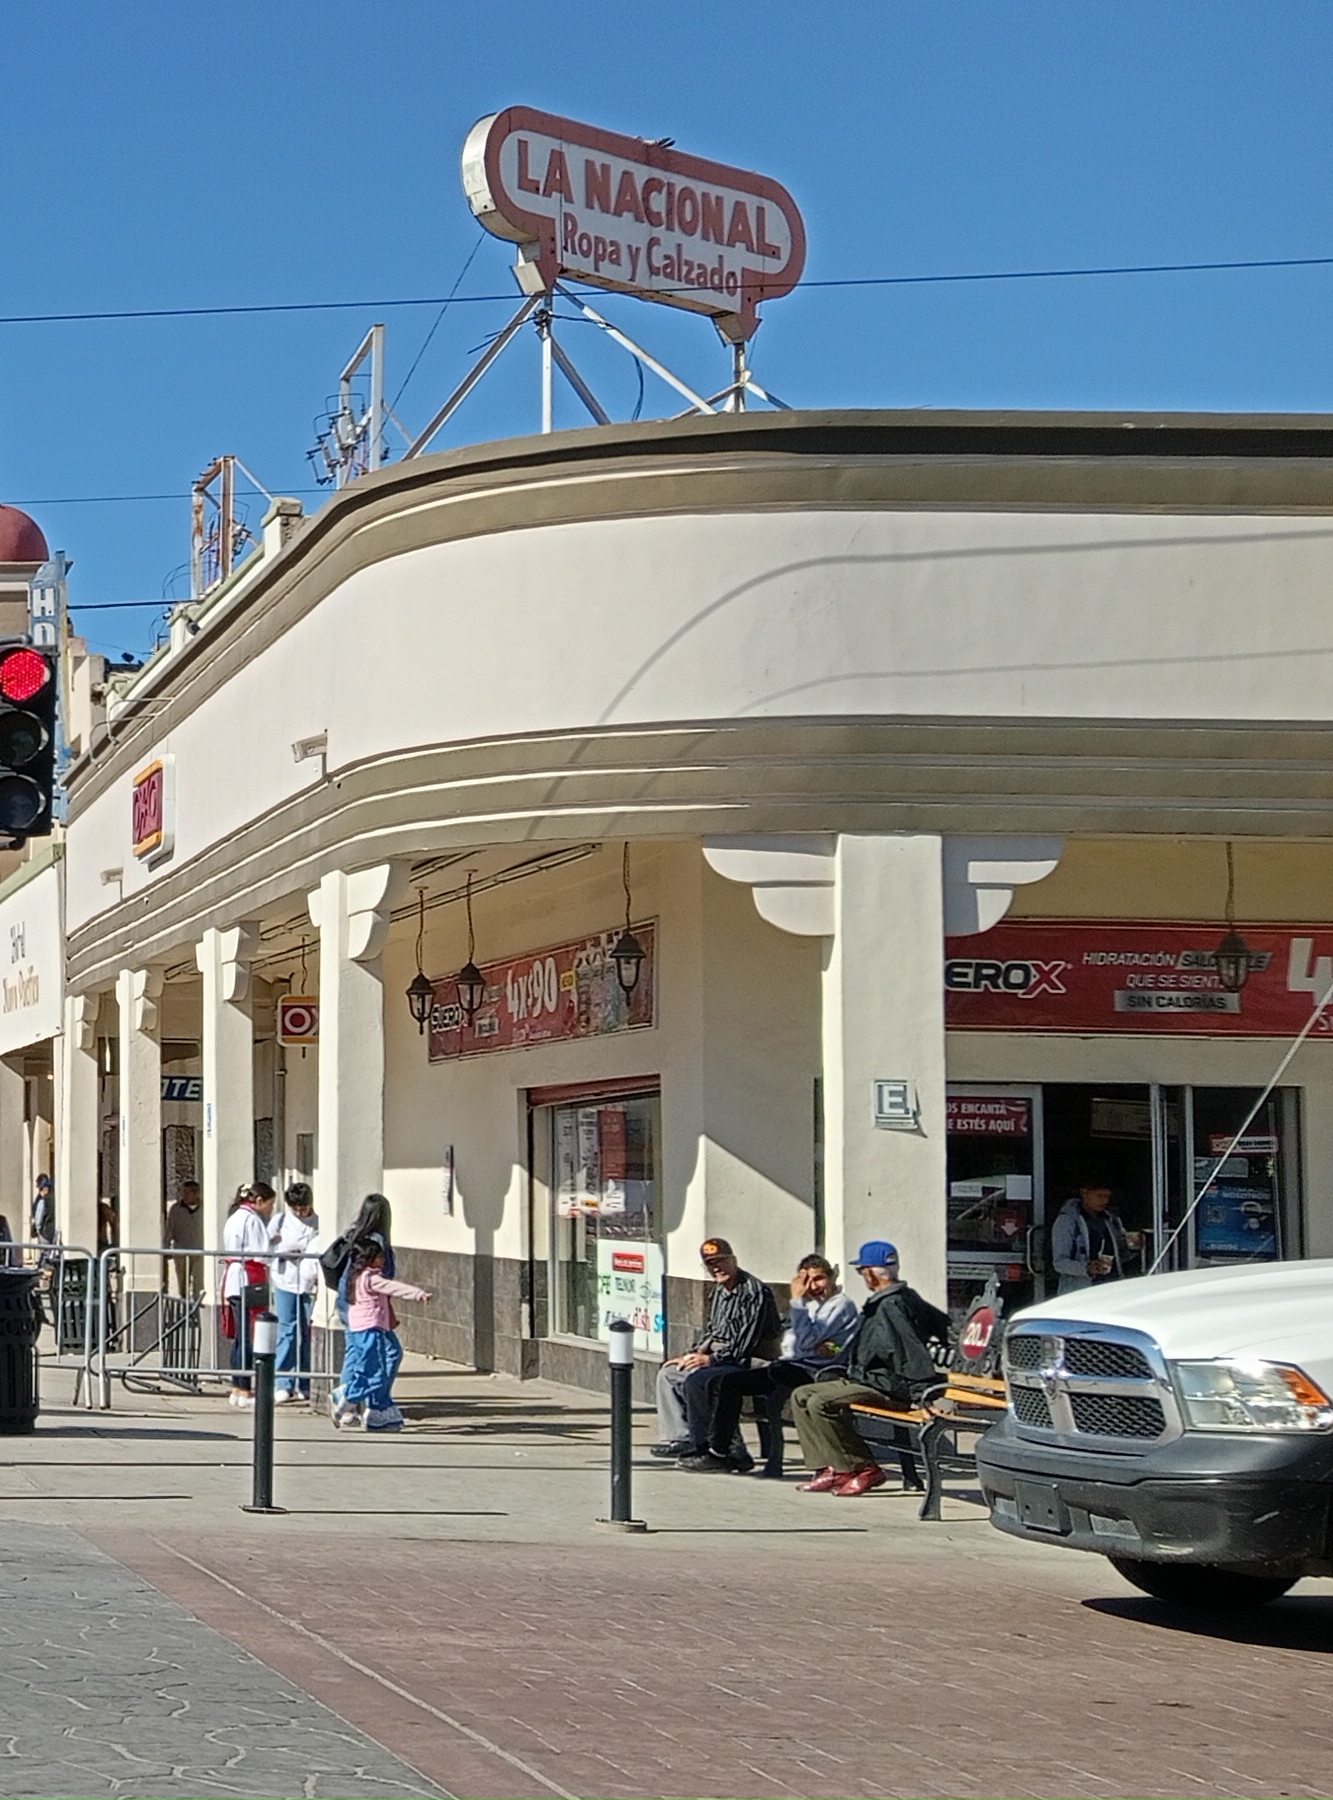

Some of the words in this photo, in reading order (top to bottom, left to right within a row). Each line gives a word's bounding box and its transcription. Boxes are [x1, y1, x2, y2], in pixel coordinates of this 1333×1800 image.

[517, 138, 574, 204] LA
[585, 158, 781, 260] NACIONAL
[563, 211, 622, 273] Ropa
[628, 243, 642, 282] y
[647, 236, 738, 297] Calzado
[1082, 951, 1176, 967] HIDRATACIÓN
[944, 959, 1067, 998] EROX
[1126, 973, 1155, 988] QUE
[1157, 974, 1176, 988] SE
[1179, 975, 1226, 989] SIENT
[1126, 994, 1152, 1009] SIN
[1156, 994, 1228, 1010] CALORÍAS
[882, 1084, 906, 1114] E
[956, 1117, 986, 1130] ESTÉS
[988, 1118, 1016, 1133] AQUÍ
